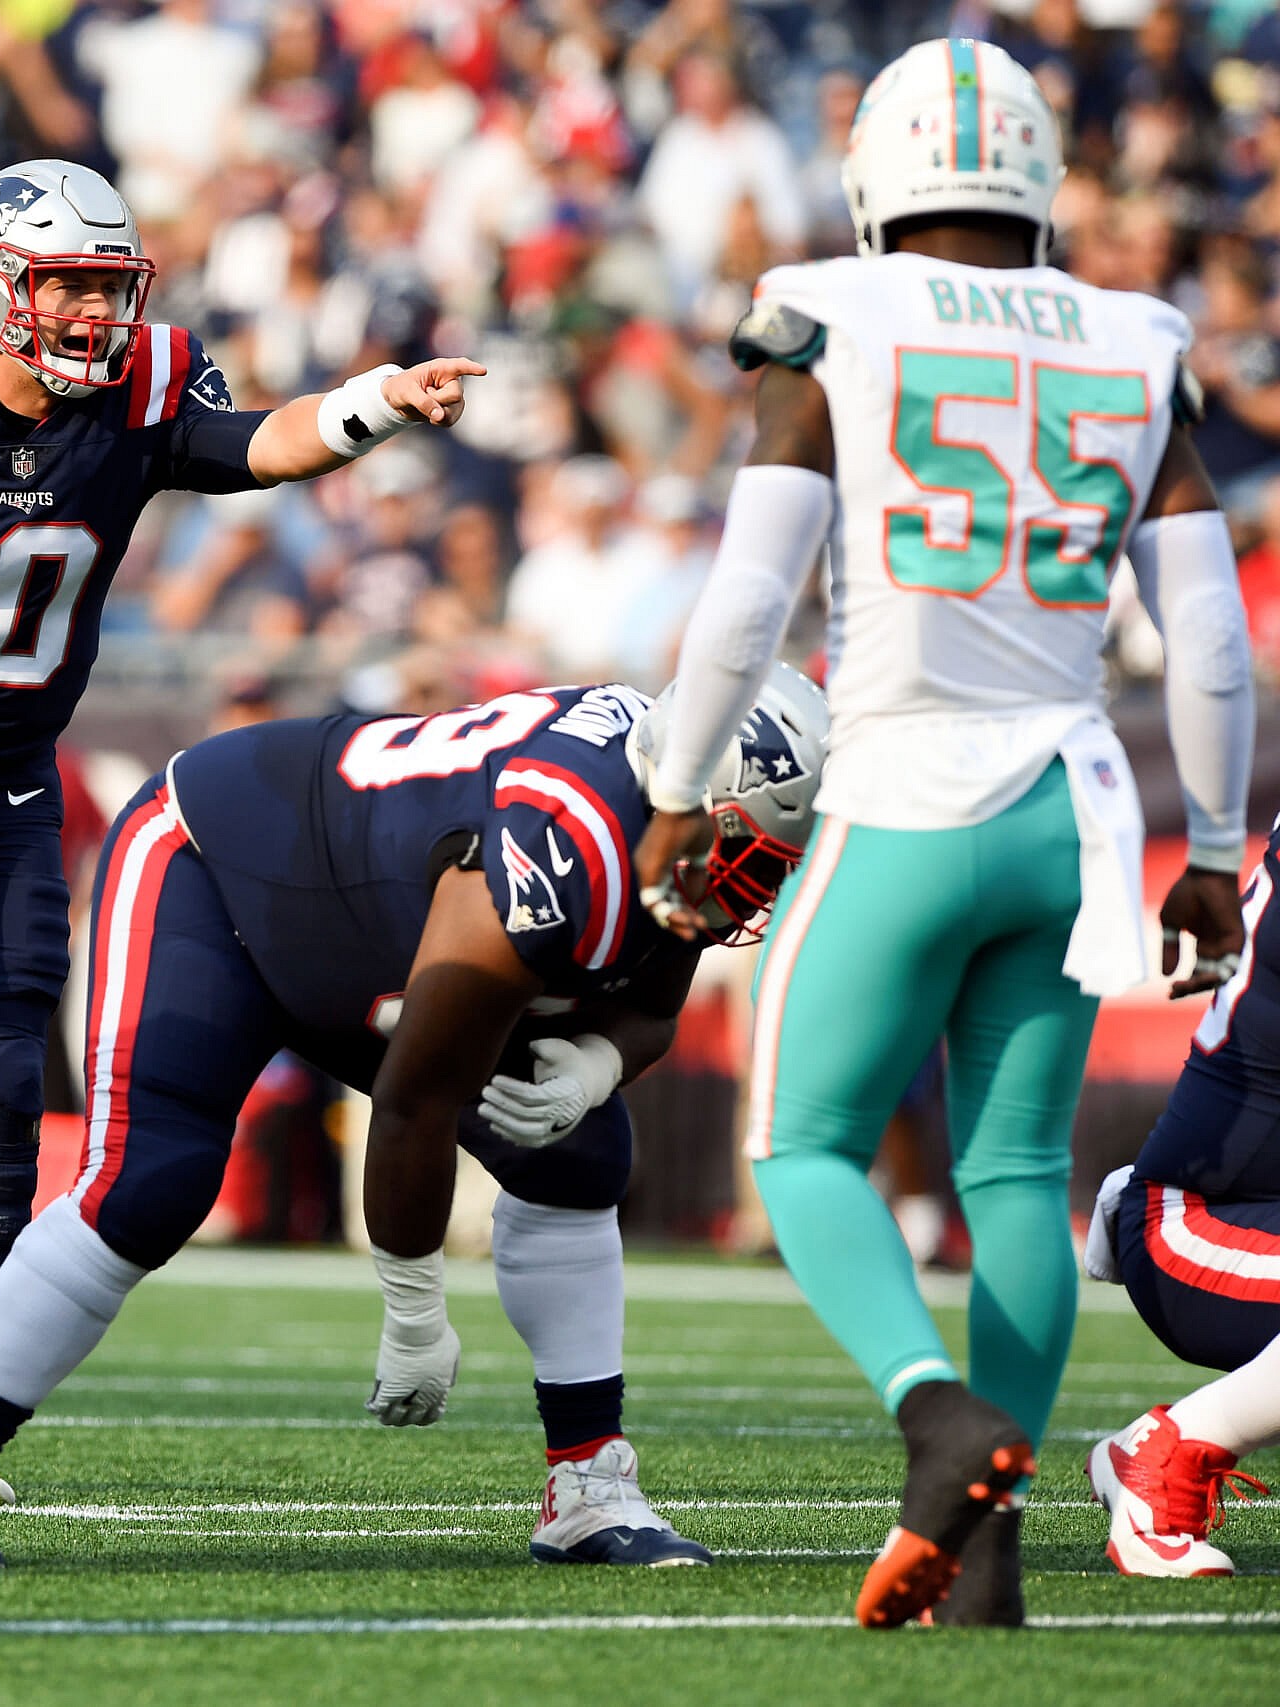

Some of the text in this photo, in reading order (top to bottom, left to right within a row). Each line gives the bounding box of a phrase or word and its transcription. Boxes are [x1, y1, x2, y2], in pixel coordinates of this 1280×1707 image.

[926, 277, 1088, 344] BAKER
[15, 461, 33, 474] NFL
[883, 344, 1152, 612] 55
